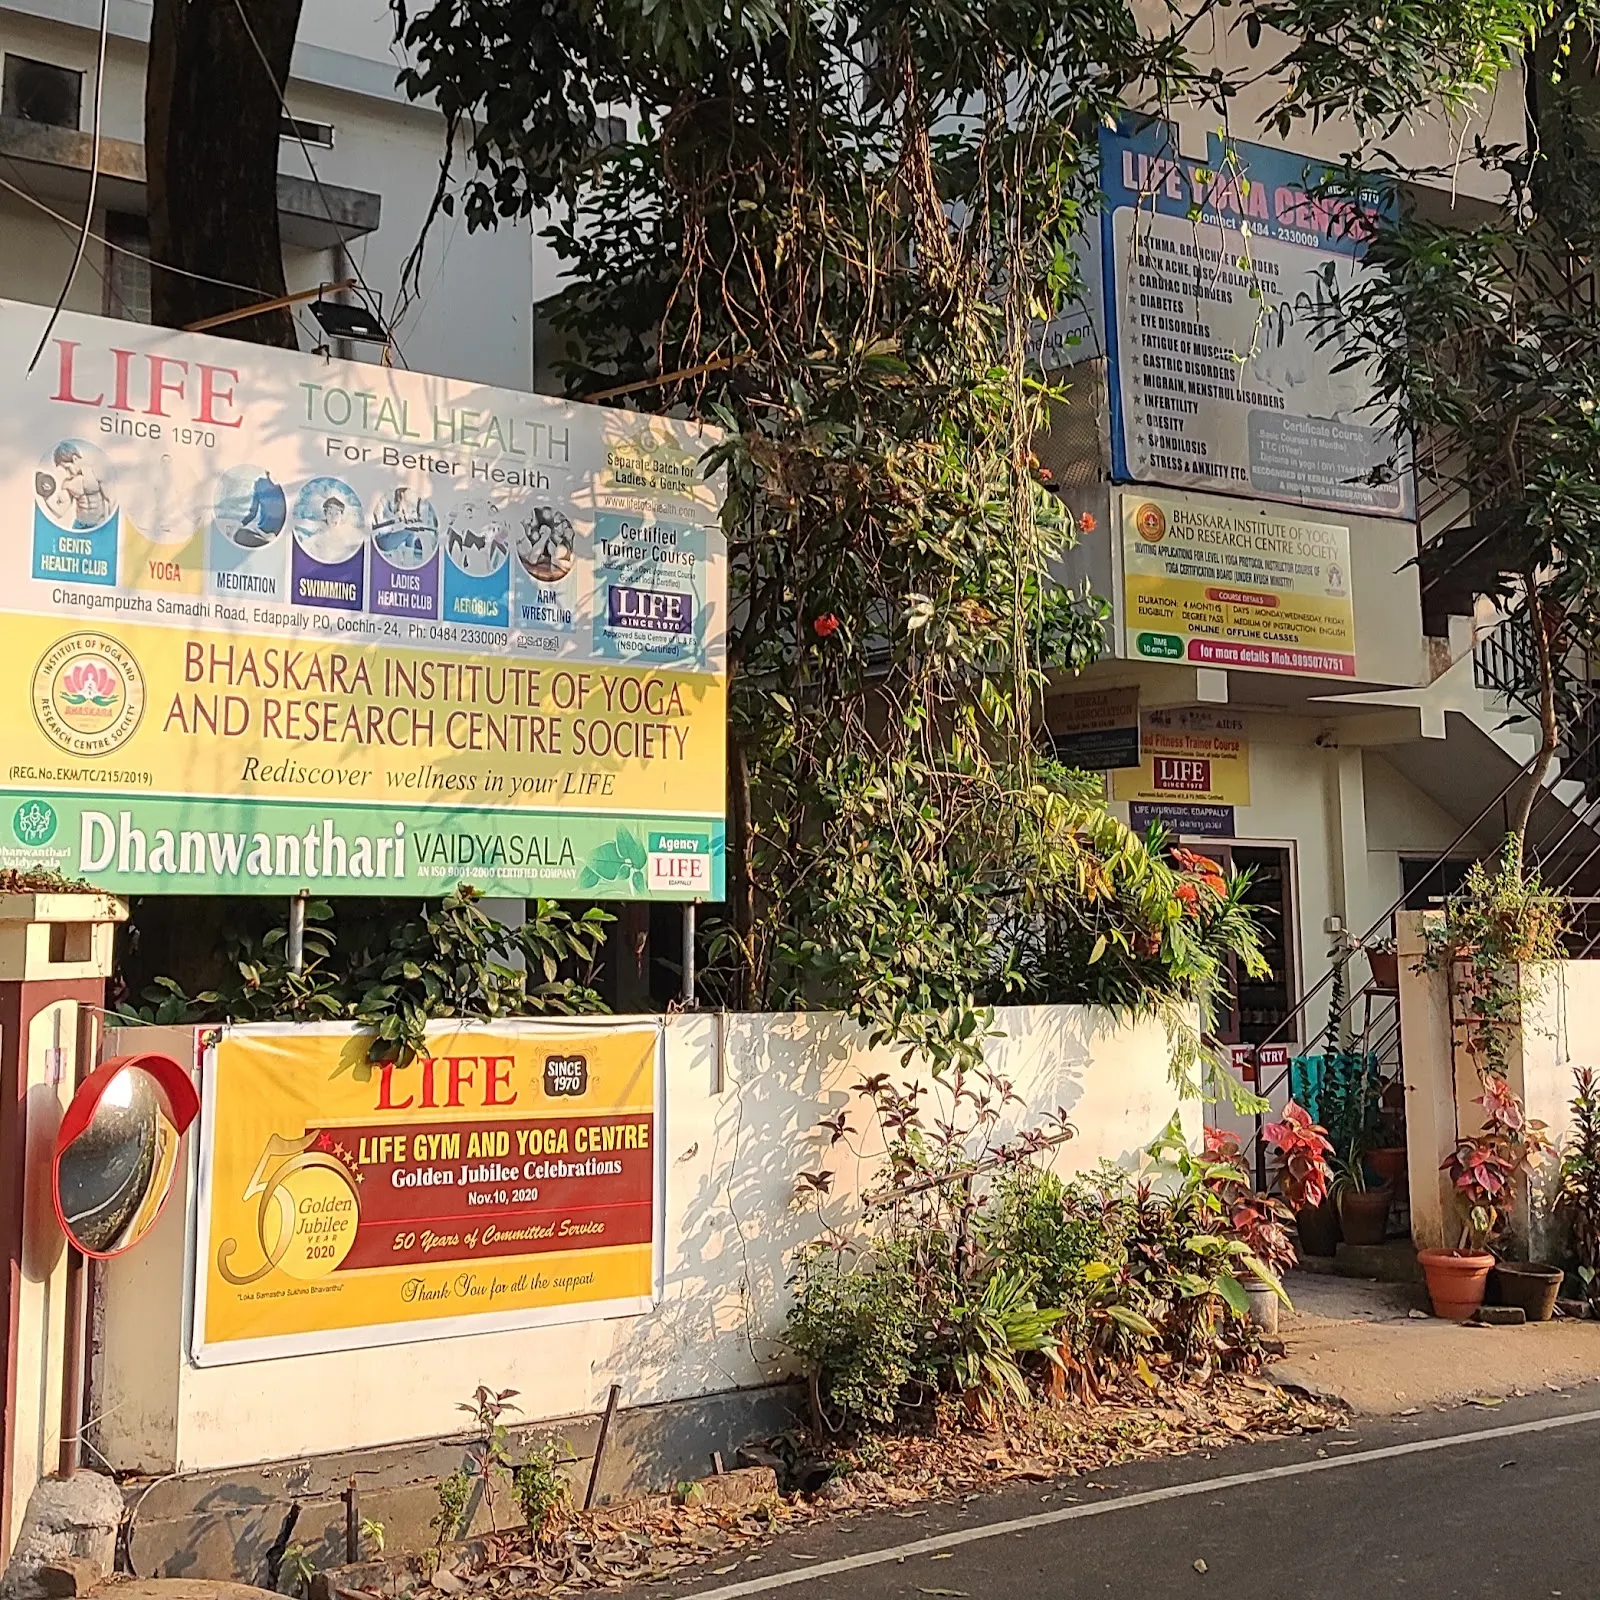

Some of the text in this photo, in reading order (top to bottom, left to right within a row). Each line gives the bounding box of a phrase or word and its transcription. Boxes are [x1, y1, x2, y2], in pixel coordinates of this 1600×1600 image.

[1121, 149, 1182, 201] LIFE
[1138, 234, 1177, 254] ASTHMA,
[1278, 227, 1319, 248] 2330009
[1138, 255, 1163, 271] BACK
[1139, 273, 1233, 304] CARDIAC DISORDERS
[1140, 293, 1184, 313] DIABETES
[1140, 314, 1210, 338] EYE DISORDERS
[1141, 333, 1192, 355] FATIGUE OF
[1142, 353, 1236, 382] GASTRIC DISORDERS
[49, 338, 243, 428] LIFE
[1143, 373, 1285, 410] MIGRAIN, MENSTRUL DISORDERS
[1144, 395, 1199, 415] INFERTILITY
[100, 412, 216, 448] since 1970
[298, 382, 570, 462] TOTAL HEALTH
[1146, 414, 1184, 432] OBESITY
[1283, 419, 1364, 442] Certificate Course
[1148, 434, 1207, 455] SPONDILOSIS
[326, 437, 550, 490] For Better Health
[607, 452, 694, 478] Separate Batch for
[1149, 453, 1249, 482] STRESS & ANXIETY ETC.
[615, 471, 686, 492] Ladies & Gents
[621, 522, 677, 545] Certified
[1173, 510, 1337, 546] BHASKARA INSTITUTE OF YOGA
[58, 537, 92, 554] GENTS
[601, 538, 696, 566] Trainer Course
[1169, 525, 1339, 560] AND RESEARCH CENTRE SOCIETY
[41, 554, 108, 576] HEALTH CLUB
[149, 560, 181, 582] YOGA
[216, 572, 276, 594] MEDITATION
[299, 577, 356, 601] SWIMMING
[390, 573, 420, 591] LADIES
[378, 590, 432, 610] HEALTH CLUB
[453, 598, 499, 617] AEROBICS
[537, 589, 557, 605] ARM
[617, 589, 683, 621] LIFE
[1218, 591, 1242, 602] COURSE
[52, 588, 508, 647] Changampuzha Samadhi Road, Edappally Ph: 0484 2330009
[521, 605, 572, 624] WRESTLING
[621, 617, 680, 630] SINCE 1970
[1182, 611, 1208, 622] DEGREE
[1208, 613, 1224, 624] PASS
[1233, 617, 1261, 628] MEDIUM
[1273, 621, 1316, 633] INSTRUCTION
[1152, 637, 1167, 646] TIME
[1188, 623, 1299, 643] ONLINE OFFLINE CLASSES
[43, 639, 135, 682] INSTITUTE OF YOGA AND
[1200, 643, 1270, 664] for more details
[184, 641, 685, 717] BHASKARA INSTITUTE OF YOGA
[42, 698, 136, 750] RESEARCH CENTRE SOCIETY
[163, 692, 690, 760] AND RESEARCH CENTRE SOCIETY
[1155, 734, 1184, 748] Fitness
[1185, 736, 1212, 750] Trainer
[1214, 737, 1240, 751] Course
[241, 756, 616, 798] Rediscover wellness in your LIFE
[1160, 760, 1204, 782] LIFE
[1162, 781, 1184, 789] SINCE
[1134, 805, 1149, 814] LIFE
[78, 810, 576, 878] Dhanwanthari VAIDYASALA
[659, 836, 699, 852] Agency
[417, 865, 577, 879] AN ISO CERTIFIED COMPANY
[655, 858, 703, 878] LIFE
[548, 1060, 582, 1077] SINCE
[374, 1055, 519, 1110] LIFE
[553, 1076, 580, 1092] 1970
[358, 1123, 649, 1165] LIFE GYM AND YOGA CENTRE
[391, 1157, 622, 1188] Golden Jubilee Celebrations
[298, 1196, 352, 1214] Golden
[468, 1187, 538, 1206] Nov.10, 2020
[296, 1216, 348, 1236] Jubilee
[392, 1218, 605, 1253] 50 Years of Committed Service
[308, 1234, 338, 1244] YEAR
[306, 1245, 335, 1260] 2020
[400, 1271, 594, 1303] Thank You for all the support
